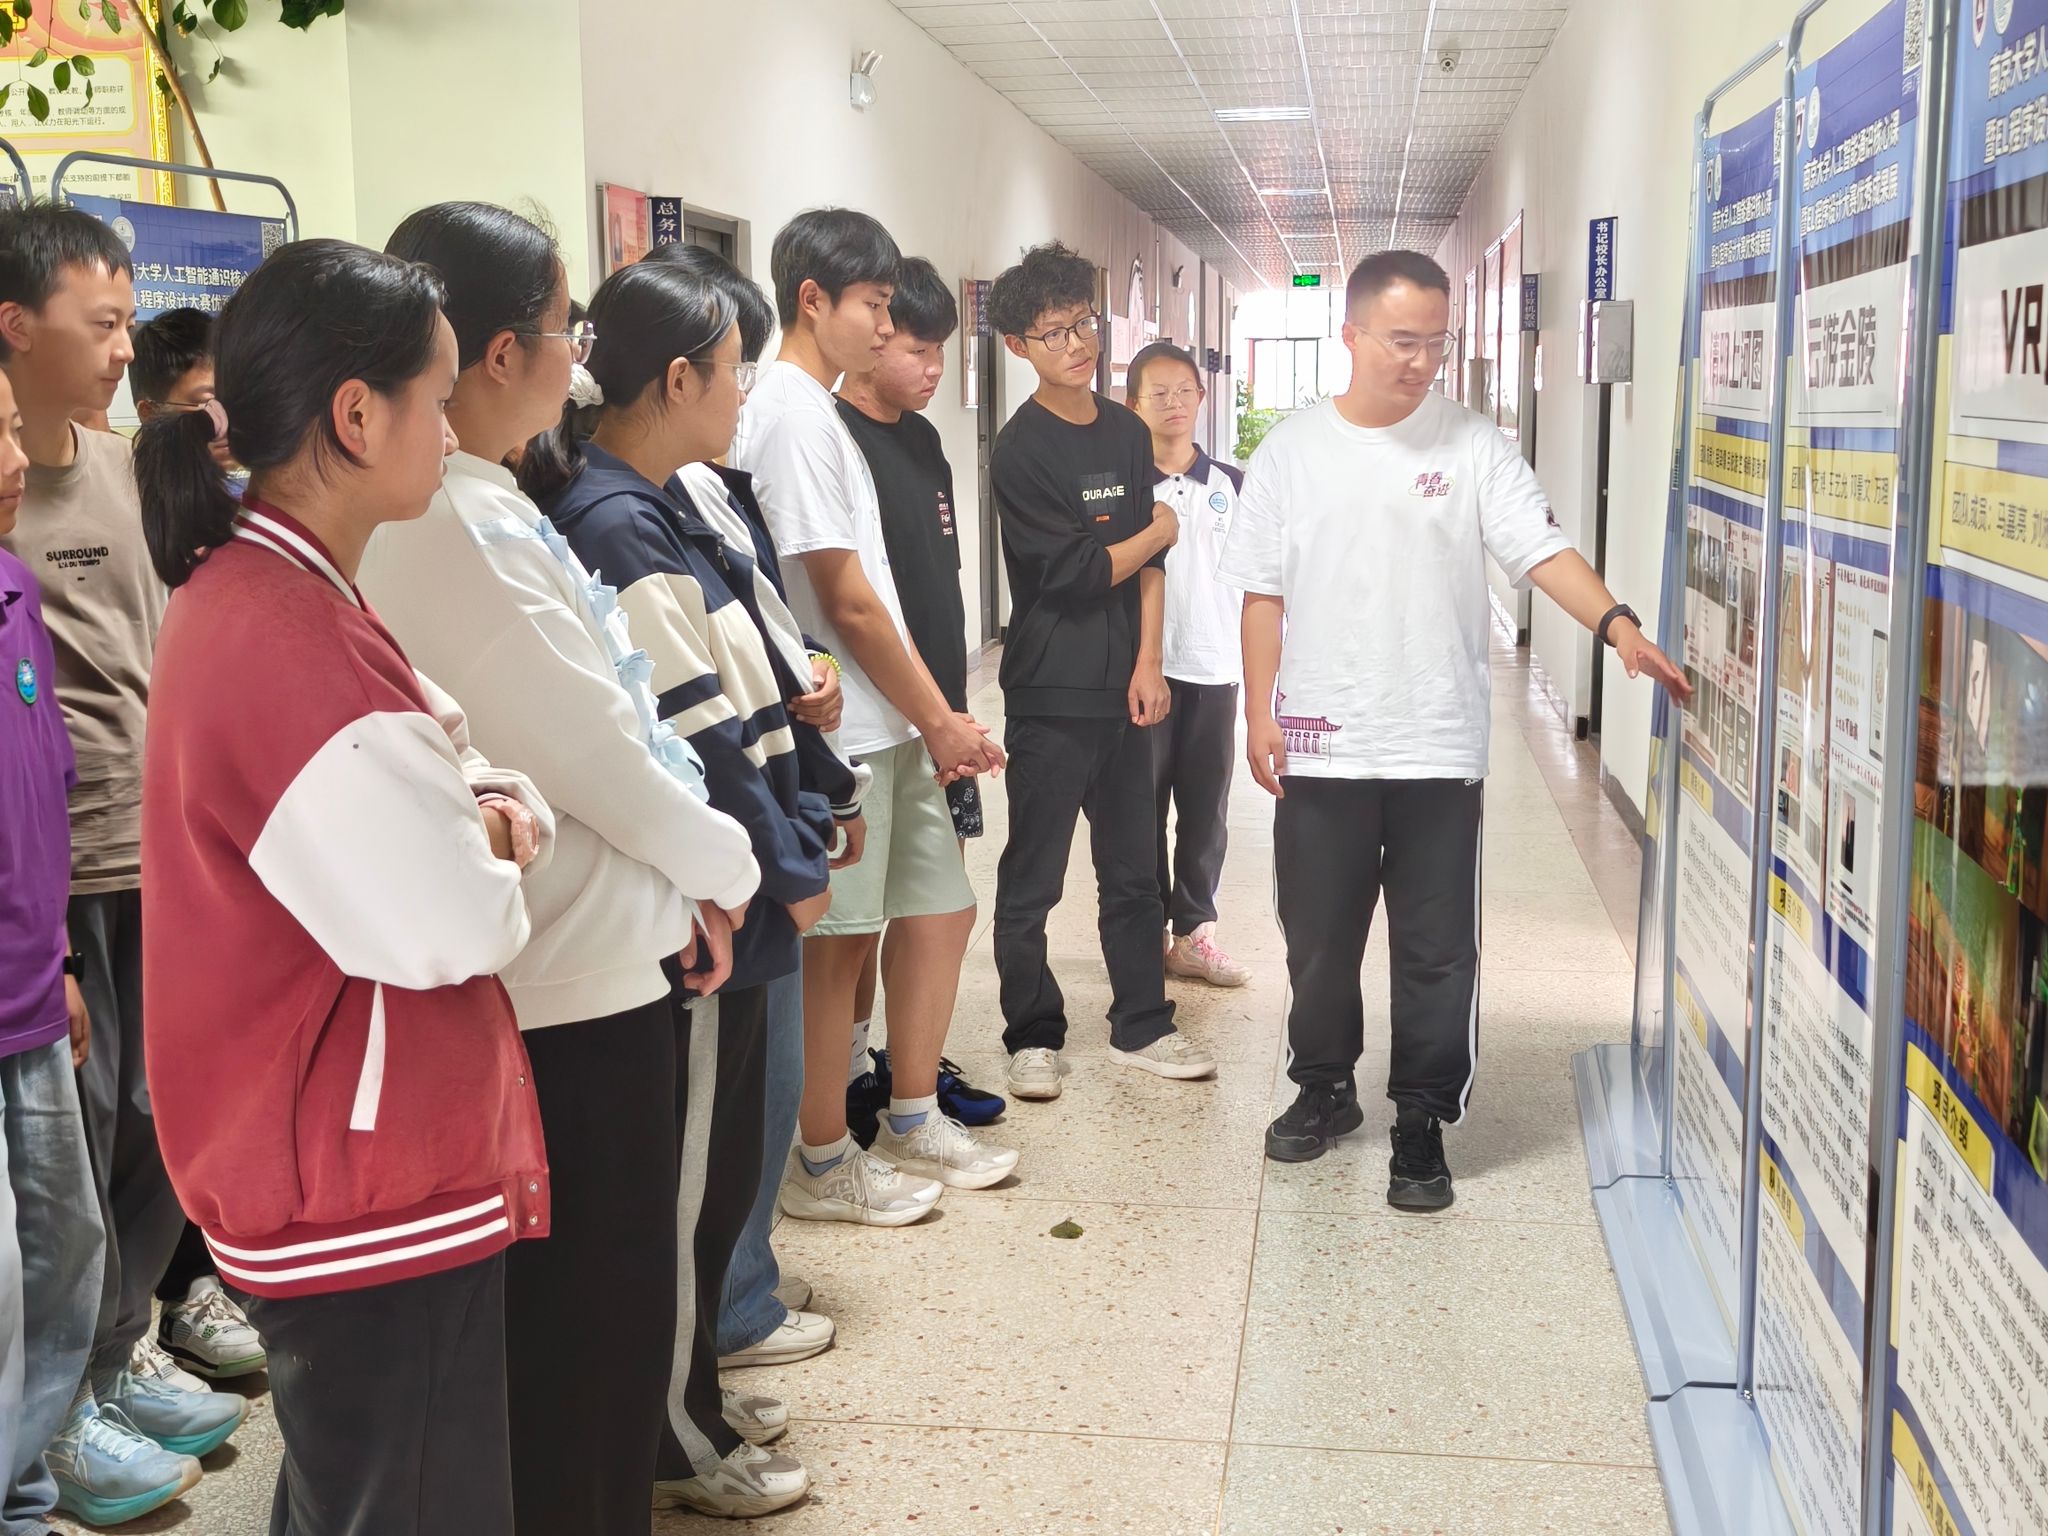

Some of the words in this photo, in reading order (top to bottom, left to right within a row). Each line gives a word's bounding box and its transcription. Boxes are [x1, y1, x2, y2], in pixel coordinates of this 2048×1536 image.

[1594, 221, 1608, 299] 书记校长办公室
[1710, 330, 1764, 390] 清明上河图
[1808, 305, 1876, 389] 云游金陵
[46, 546, 109, 562] SURROUND
[1924, 1079, 1968, 1151] 项目介绍
